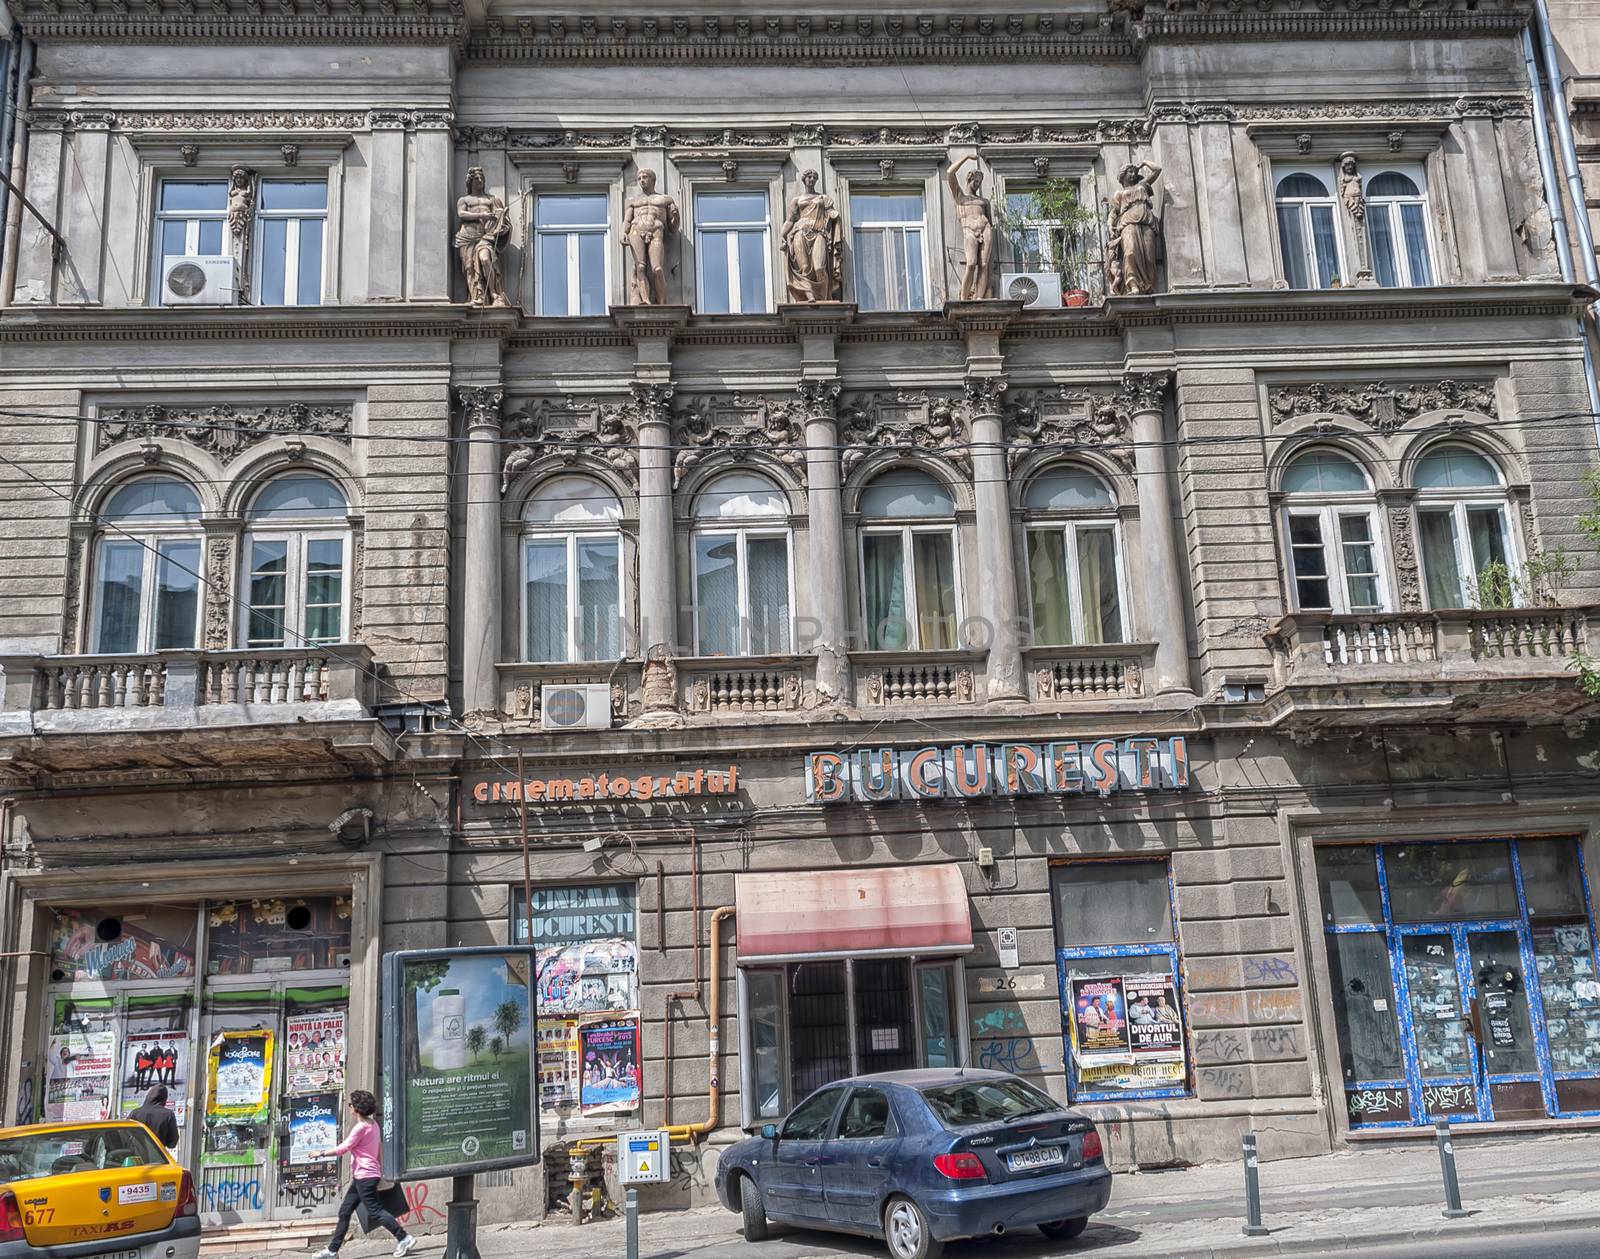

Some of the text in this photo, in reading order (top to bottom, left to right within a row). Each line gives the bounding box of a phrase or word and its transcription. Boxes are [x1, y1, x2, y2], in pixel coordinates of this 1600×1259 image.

[473, 766, 738, 802] cinematograful
[531, 887, 620, 910] CINEMA
[996, 976, 1017, 990] 26
[314, 1021, 322, 1030] LA
[323, 1019, 343, 1030] PALAT
[1138, 1032, 1173, 1043] DE AUR
[412, 1076, 444, 1087] Natura
[446, 1075, 462, 1084] are
[491, 1071, 500, 1080] ei
[1013, 1148, 1060, 1166] CT 88 CAD
[126, 1185, 150, 1195] 9435
[24, 1207, 55, 1226] 677
